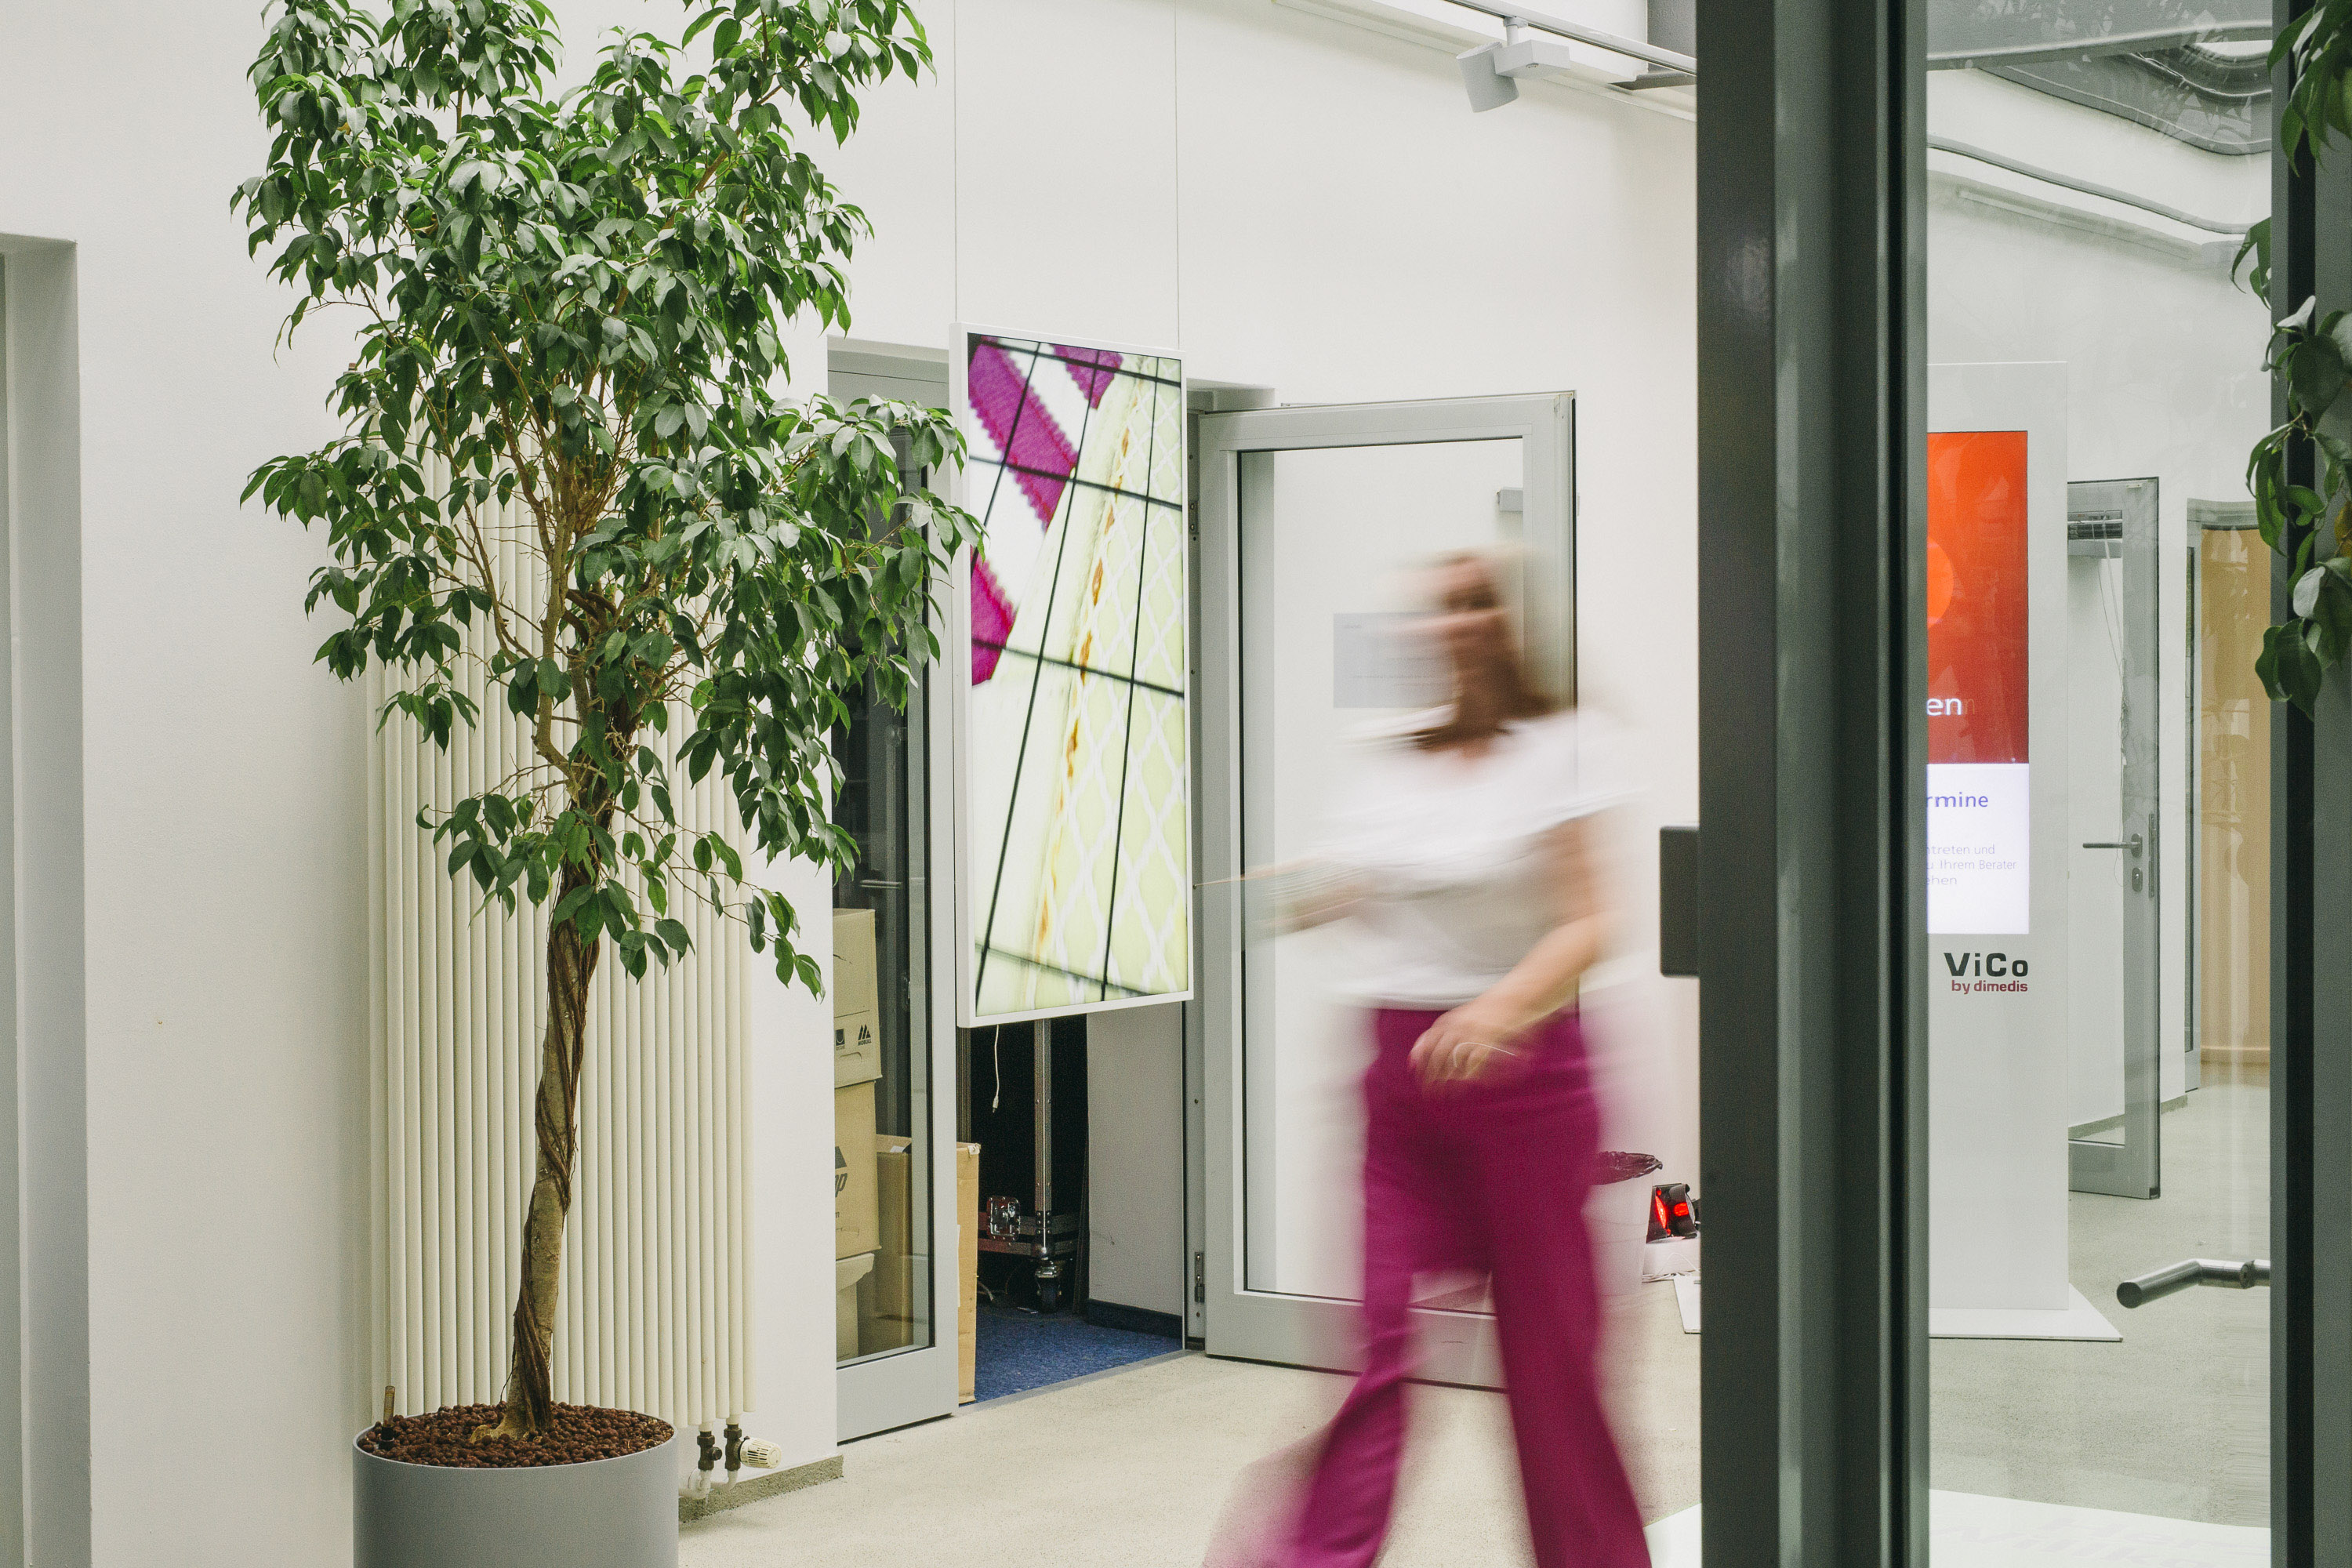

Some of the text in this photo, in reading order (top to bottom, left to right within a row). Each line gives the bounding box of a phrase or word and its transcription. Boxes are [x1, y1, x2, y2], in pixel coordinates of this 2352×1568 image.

[1974, 844, 1995, 855] und
[1940, 859, 1975, 869] Ihrem
[1979, 859, 2016, 869] Berater
[1944, 952, 2028, 977] ViCo
[1951, 979, 2028, 995] by dimedis
